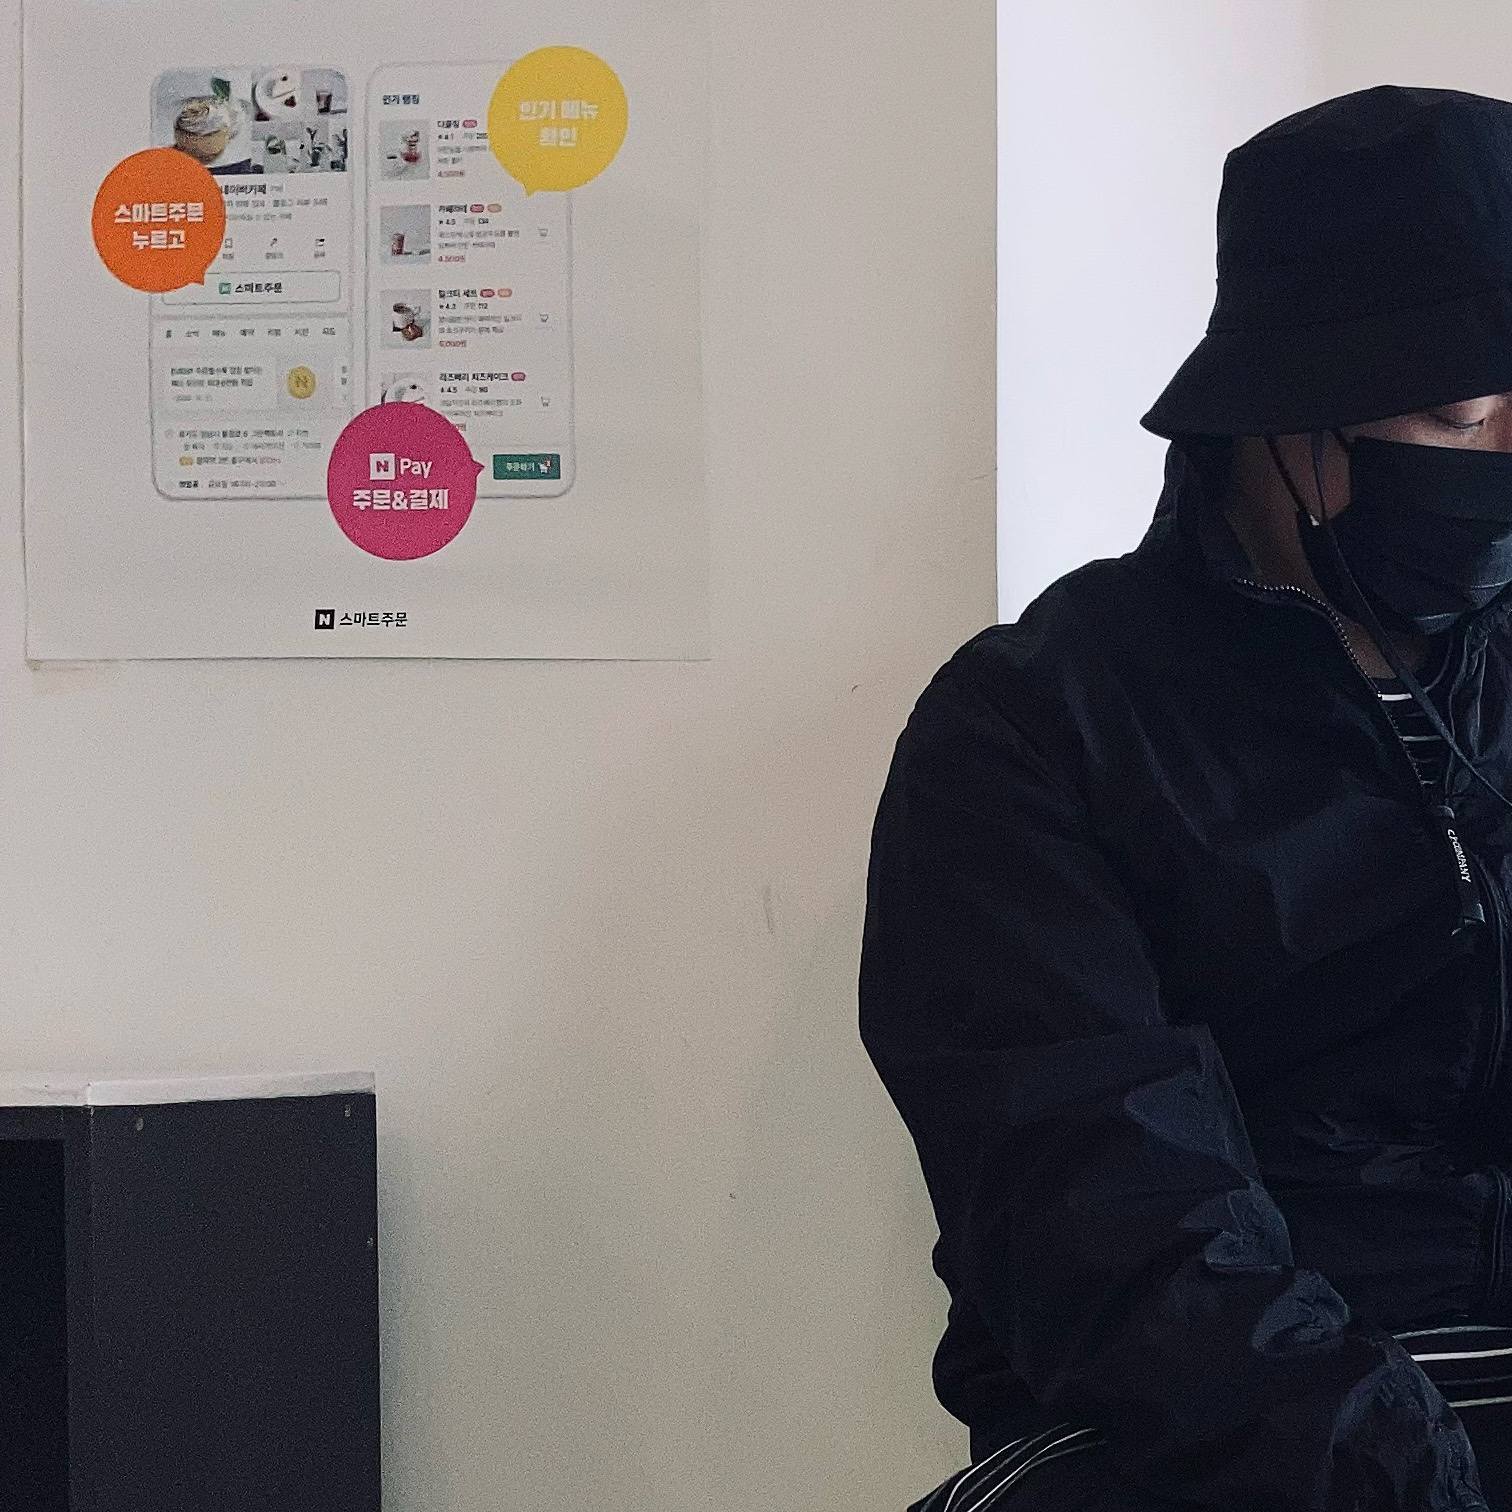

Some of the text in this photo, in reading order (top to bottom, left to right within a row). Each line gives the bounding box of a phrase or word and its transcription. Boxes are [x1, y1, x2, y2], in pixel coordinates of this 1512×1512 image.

[519, 99, 599, 120] 인기 메뉴
[114, 202, 204, 223] 스마트주문
[132, 229, 185, 250] 누르고
[235, 282, 283, 293] 스마트주문
[400, 458, 433, 478] Pay
[352, 488, 449, 510] 주문&결제
[339, 612, 407, 627] 스마트주문
